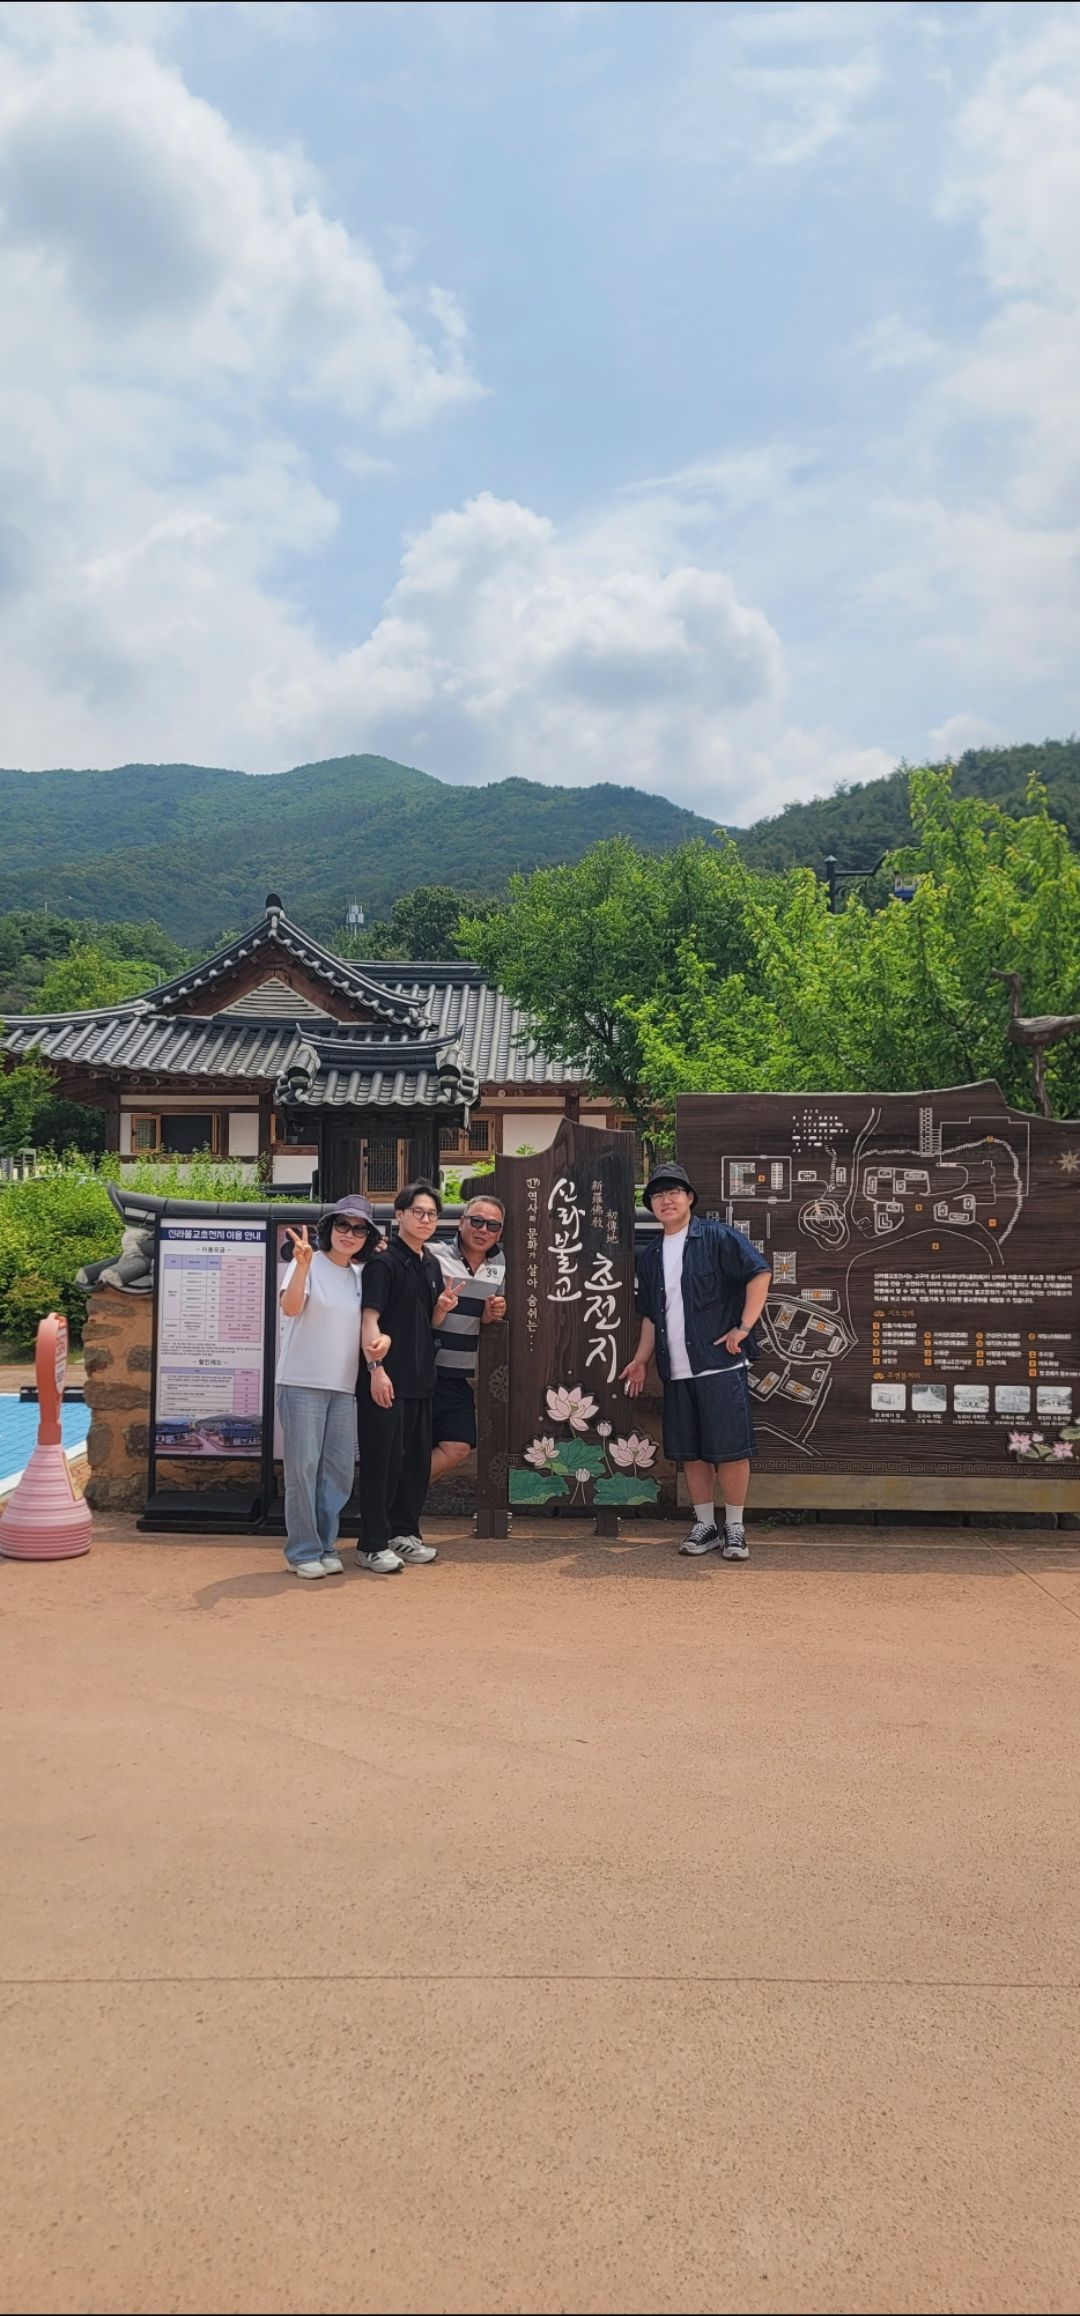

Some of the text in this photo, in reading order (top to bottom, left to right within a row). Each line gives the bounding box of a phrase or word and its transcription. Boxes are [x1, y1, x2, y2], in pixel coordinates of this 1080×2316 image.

[526, 1191, 539, 1223] 역사와
[168, 1229, 261, 1241] 신라불교초전지 이용 안내
[526, 1227, 539, 1259] 문화가
[526, 1264, 539, 1289] 살아
[547, 1178, 623, 1383] 신라불교 초전지
